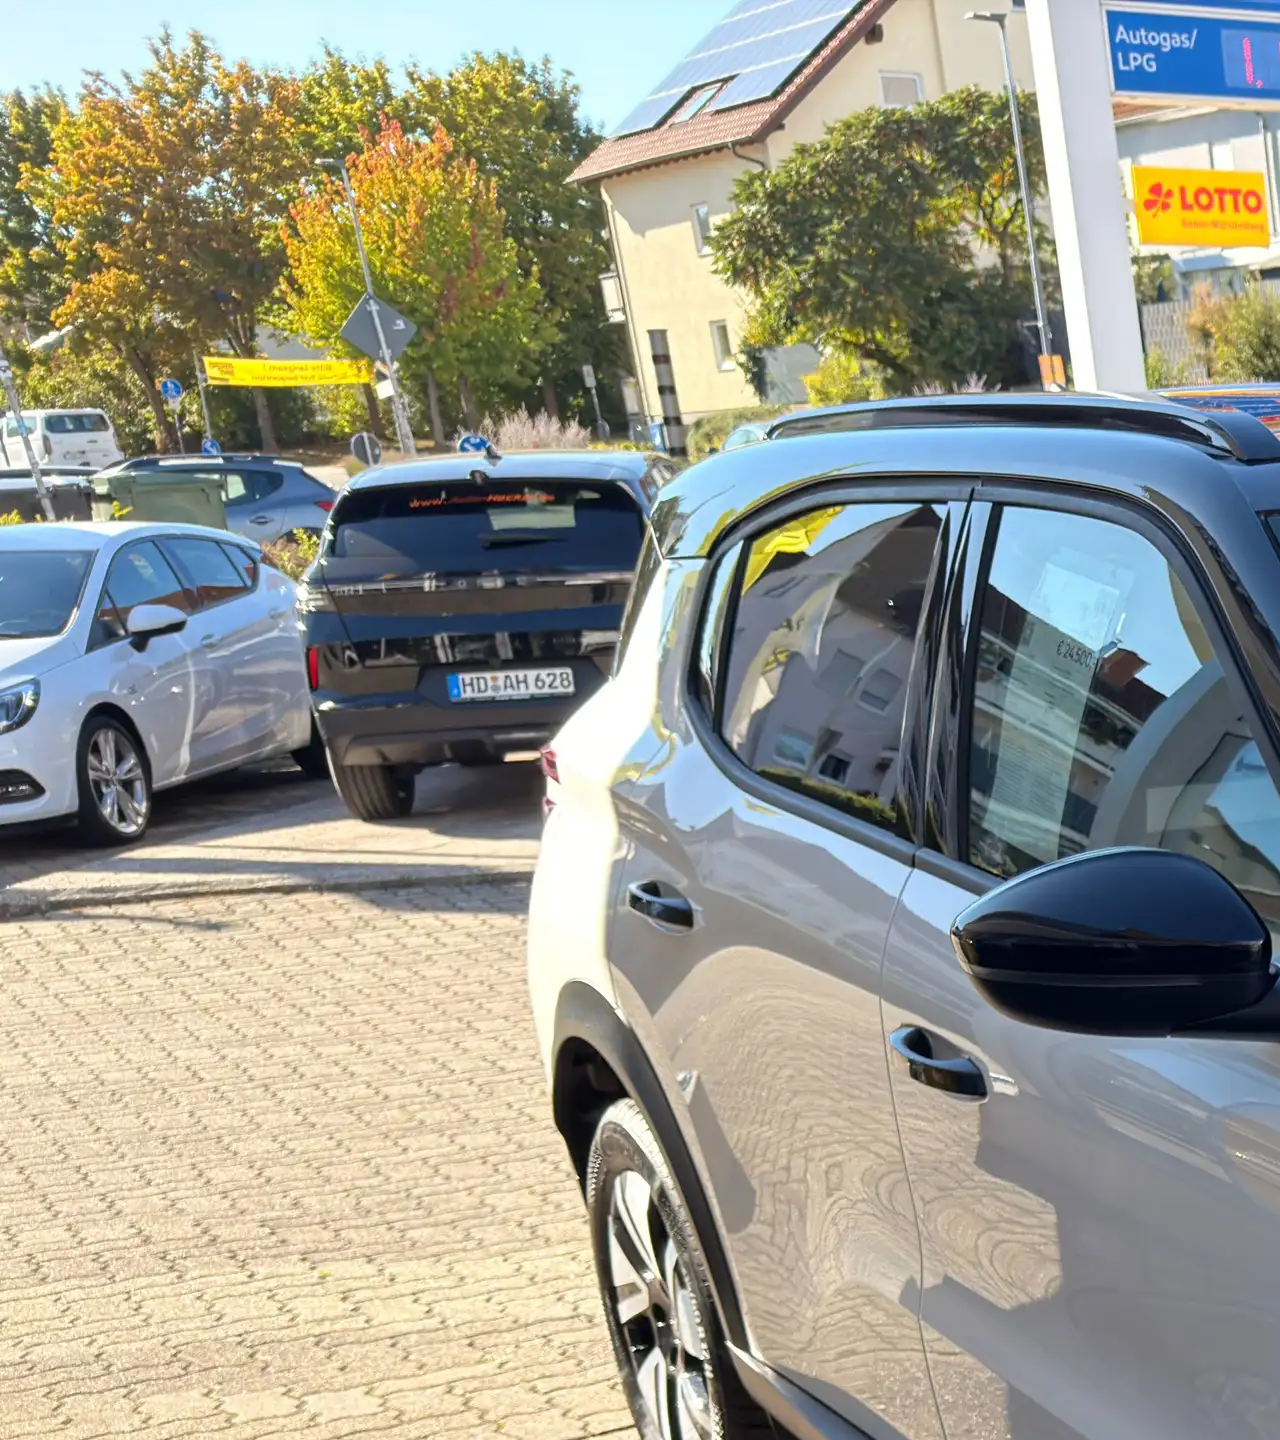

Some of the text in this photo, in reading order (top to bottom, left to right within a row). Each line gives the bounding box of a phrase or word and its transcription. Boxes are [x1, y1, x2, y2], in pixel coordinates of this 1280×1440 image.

[1115, 25, 1198, 52] Autogas/
[1117, 52, 1158, 73] LPG
[1179, 185, 1263, 214] LOTTO
[461, 671, 572, 695] HD AH 628
